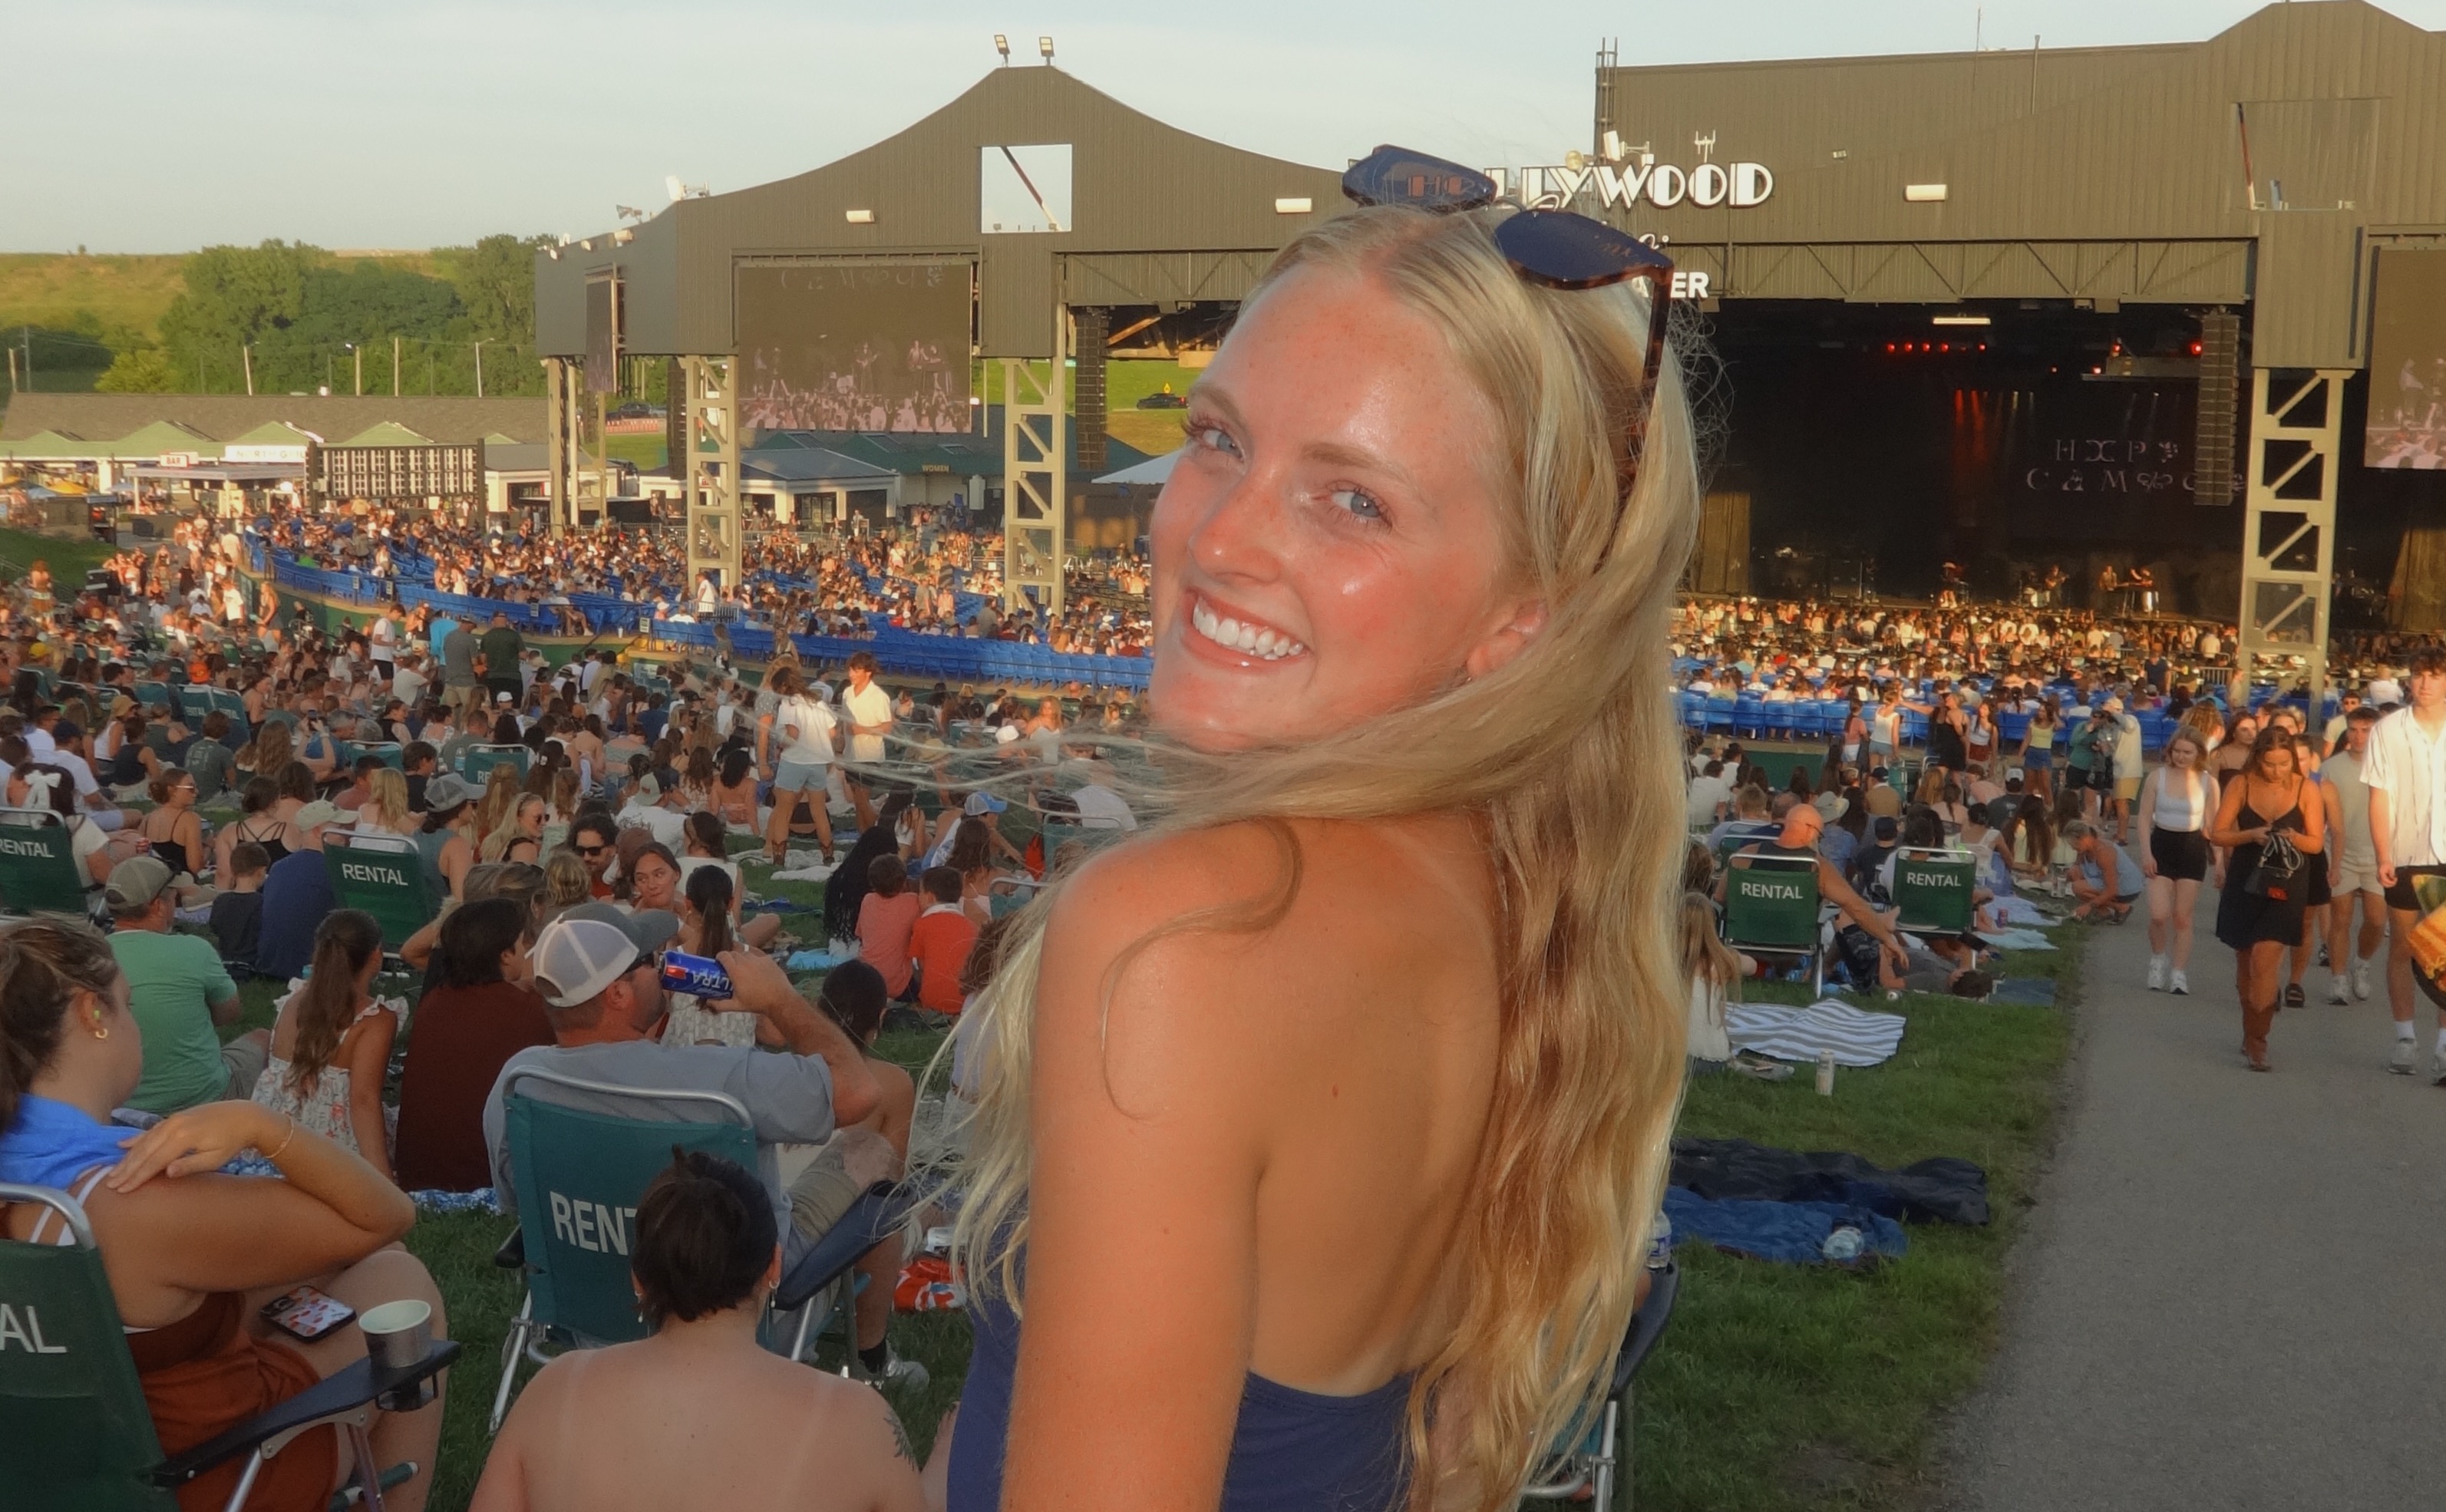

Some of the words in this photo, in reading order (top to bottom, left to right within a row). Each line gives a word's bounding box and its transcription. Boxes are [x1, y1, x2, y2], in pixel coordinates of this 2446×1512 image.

[342, 863, 408, 886] RENTAL
[1906, 872, 1962, 887] RENTAL
[1741, 882, 1804, 900] RENTAL
[692, 969, 733, 992] LTRA
[550, 1190, 638, 1256] REN
